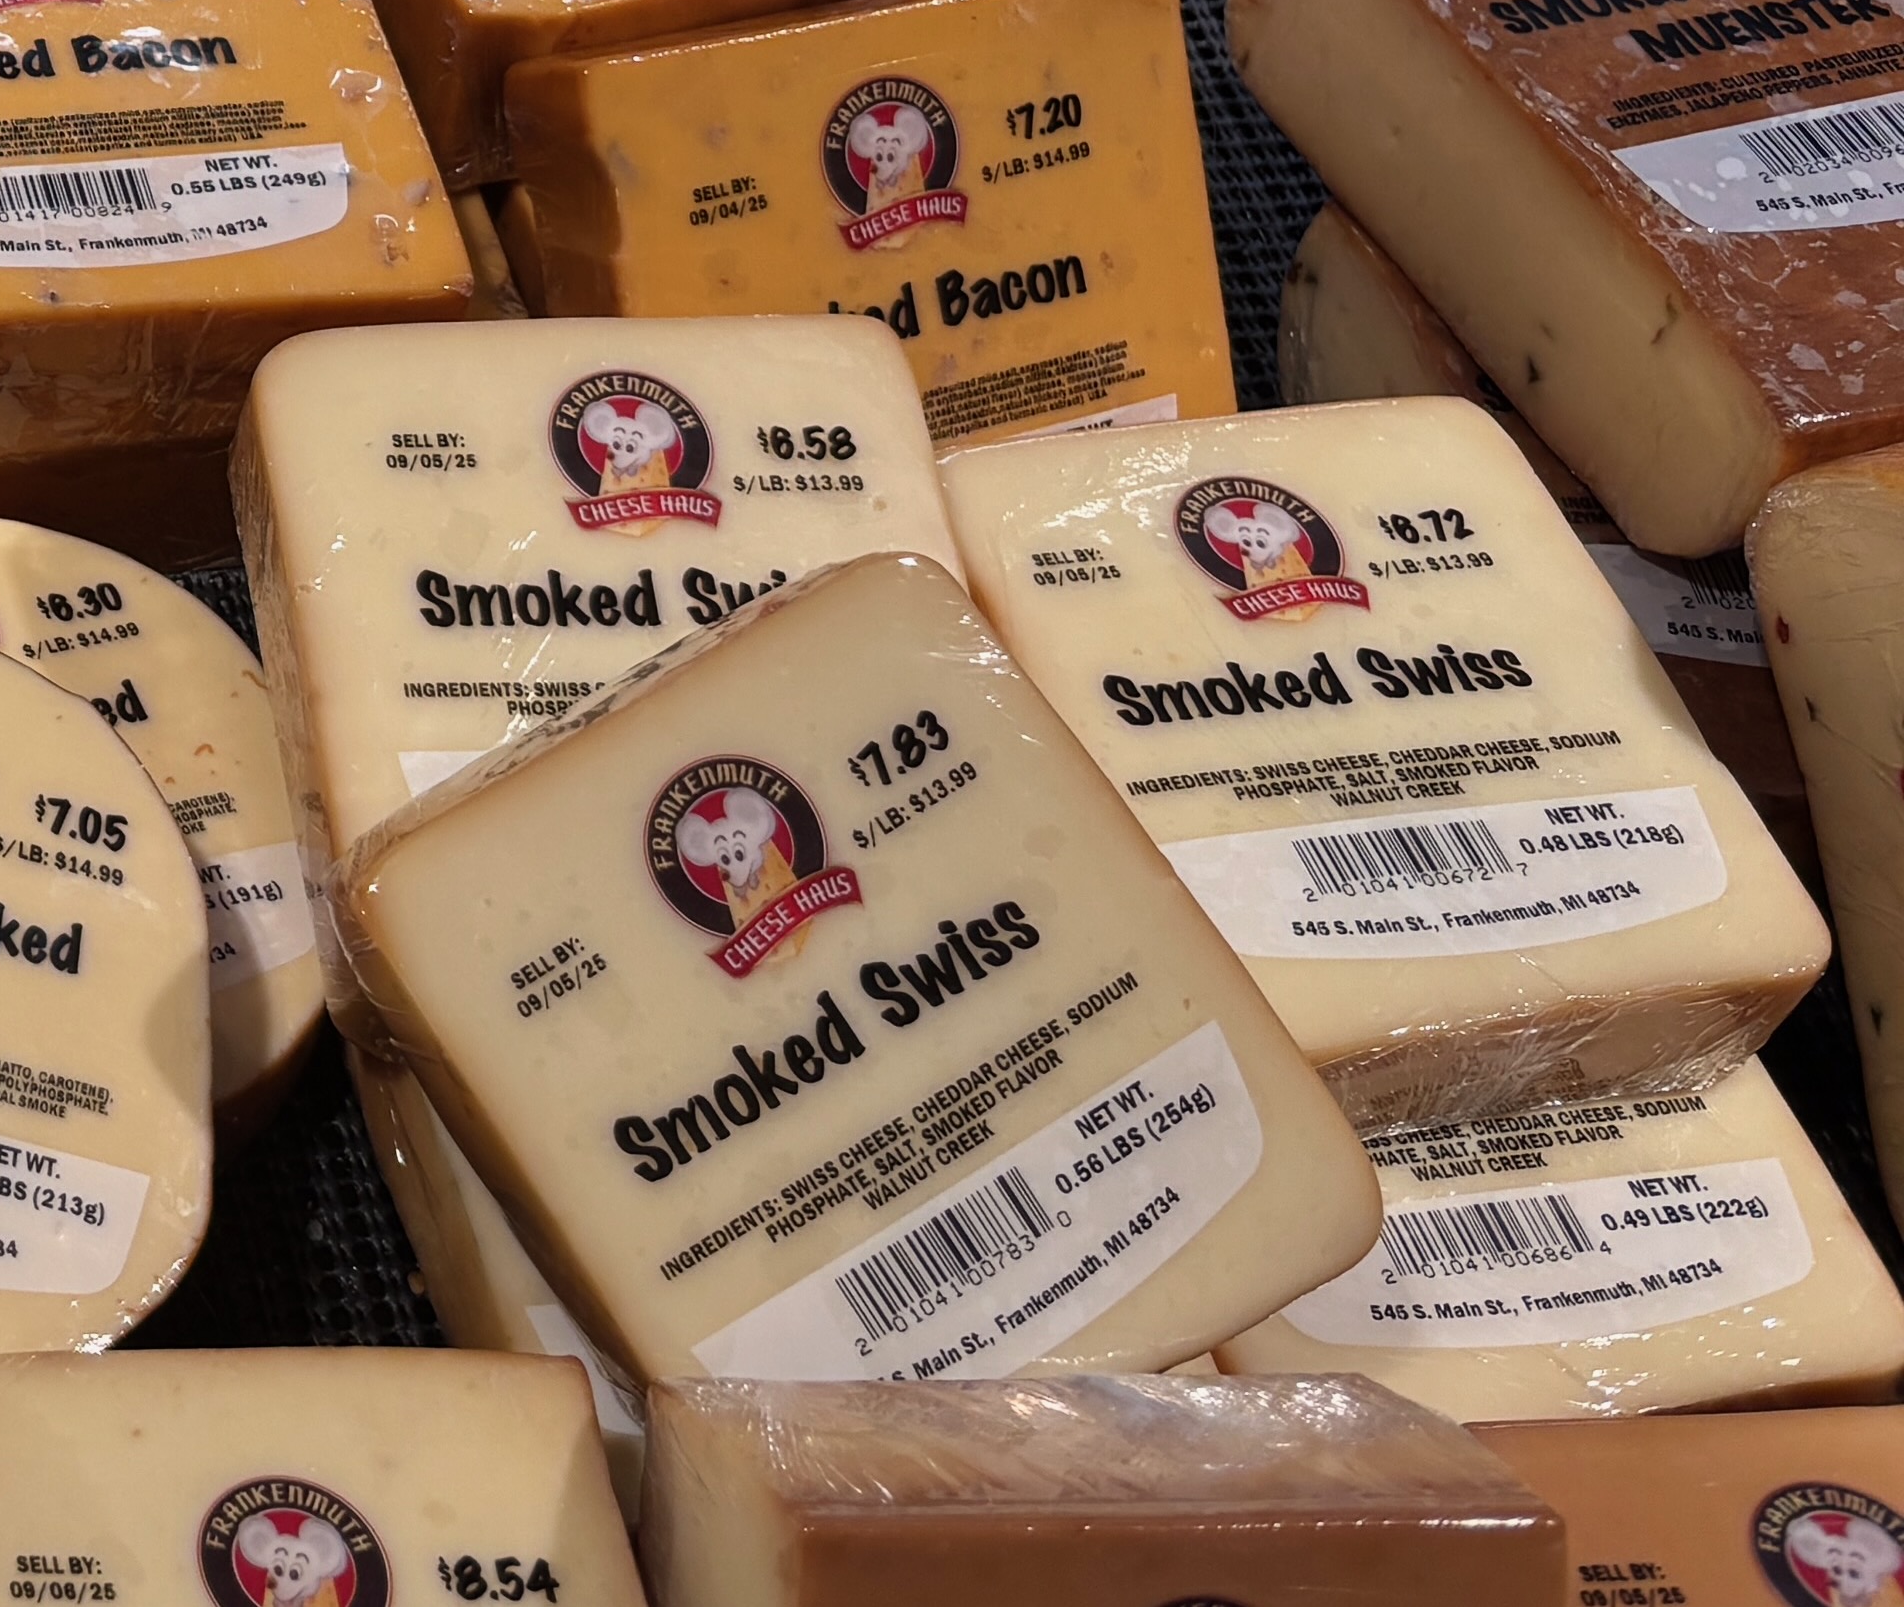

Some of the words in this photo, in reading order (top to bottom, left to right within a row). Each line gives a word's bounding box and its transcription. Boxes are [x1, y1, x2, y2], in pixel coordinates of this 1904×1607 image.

[71, 32, 238, 74] Bacon
[1006, 94, 1081, 141] $7.20
[935, 253, 1088, 327] Bacon
[415, 568, 661, 629] Smoked
[1102, 651, 1354, 729] Smoked
[1358, 643, 1534, 697] Swiss
[847, 709, 951, 791] $7.83
[33, 793, 129, 853] $7.05
[649, 760, 792, 871] FRANKENMUTH
[723, 910, 791, 975] CHEESE
[792, 873, 852, 918] HAUS
[612, 991, 868, 1184] Smoked
[858, 900, 1042, 1032] Swiss
[19, 1149, 62, 1179] WT.
[1601, 1209, 1651, 1231] 0.49
[1655, 1205, 1693, 1226] LBS
[1698, 1195, 1769, 1225] (222g)
[438, 1555, 558, 1604] $8.54
